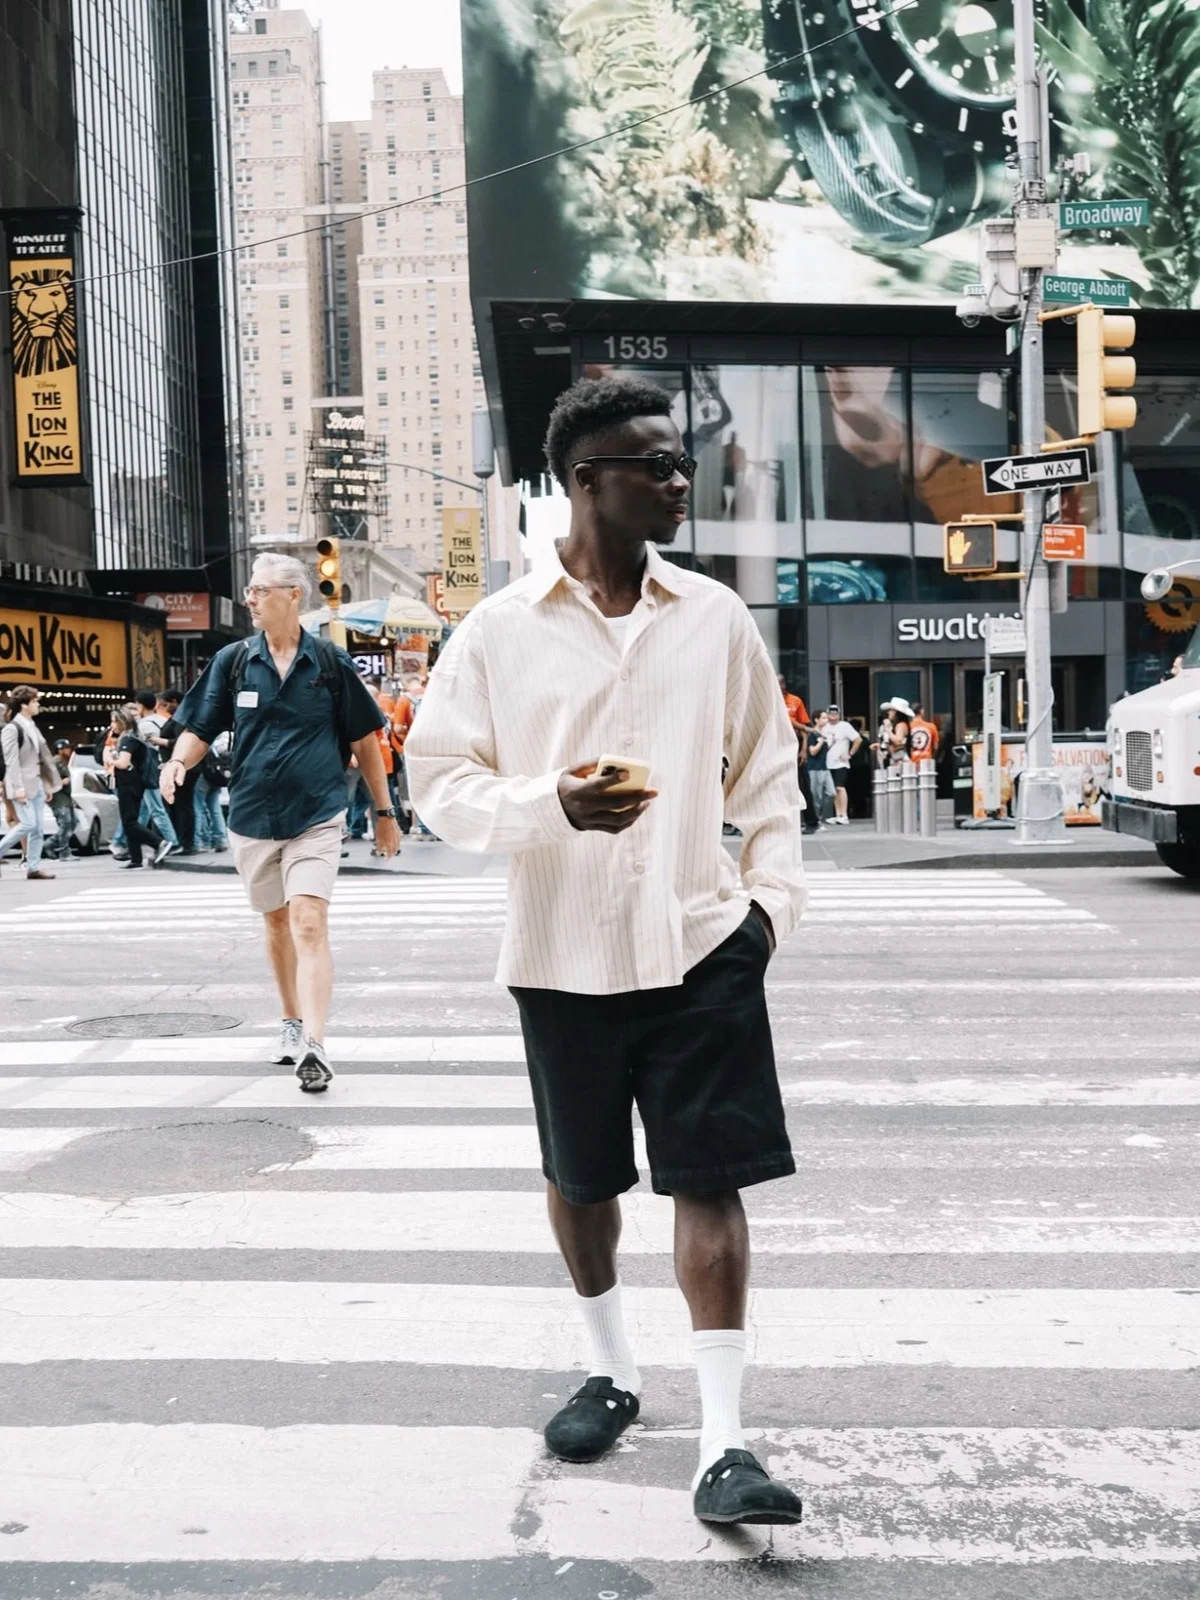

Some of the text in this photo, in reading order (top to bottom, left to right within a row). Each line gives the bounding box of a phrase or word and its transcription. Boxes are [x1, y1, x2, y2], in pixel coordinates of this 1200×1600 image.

[1064, 204, 1143, 226] Broadway
[1045, 279, 1126, 297] George Abbott
[604, 335, 668, 359] 1535
[31, 391, 62, 405] THE
[326, 411, 366, 430] Booth
[312, 468, 338, 478] JOHN
[1000, 461, 1074, 482] ONE WAY
[346, 484, 366, 495] THE
[451, 536, 473, 547] THE
[165, 594, 194, 605] CITY
[897, 612, 1013, 641] swat
[0, 623, 36, 662] ON
